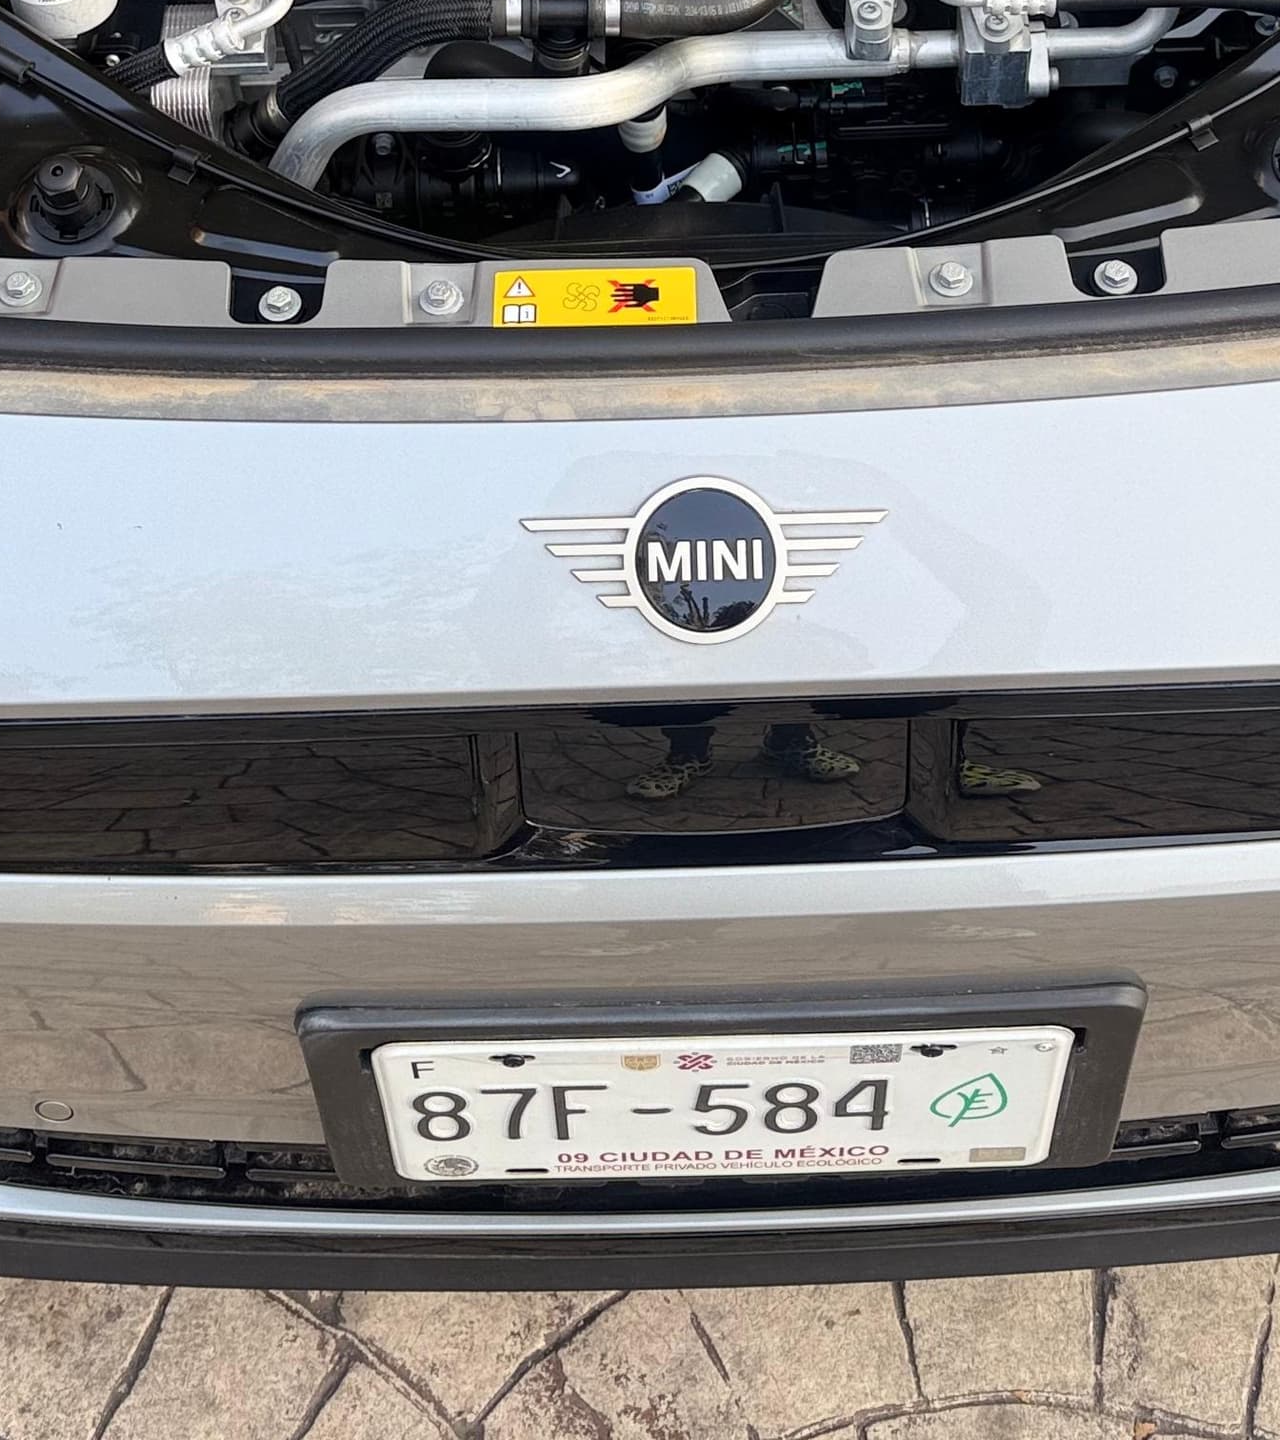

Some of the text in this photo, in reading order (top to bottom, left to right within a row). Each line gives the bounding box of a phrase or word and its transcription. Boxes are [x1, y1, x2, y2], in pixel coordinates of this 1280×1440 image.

[646, 538, 764, 583] MINI
[410, 1059, 435, 1081] F
[557, 1145, 890, 1163] 09 CIUDAD DE MÉXICO
[554, 1157, 882, 1173] TRANSPORTE PRIVADO VEHÍCULO ECOLÓGICO
